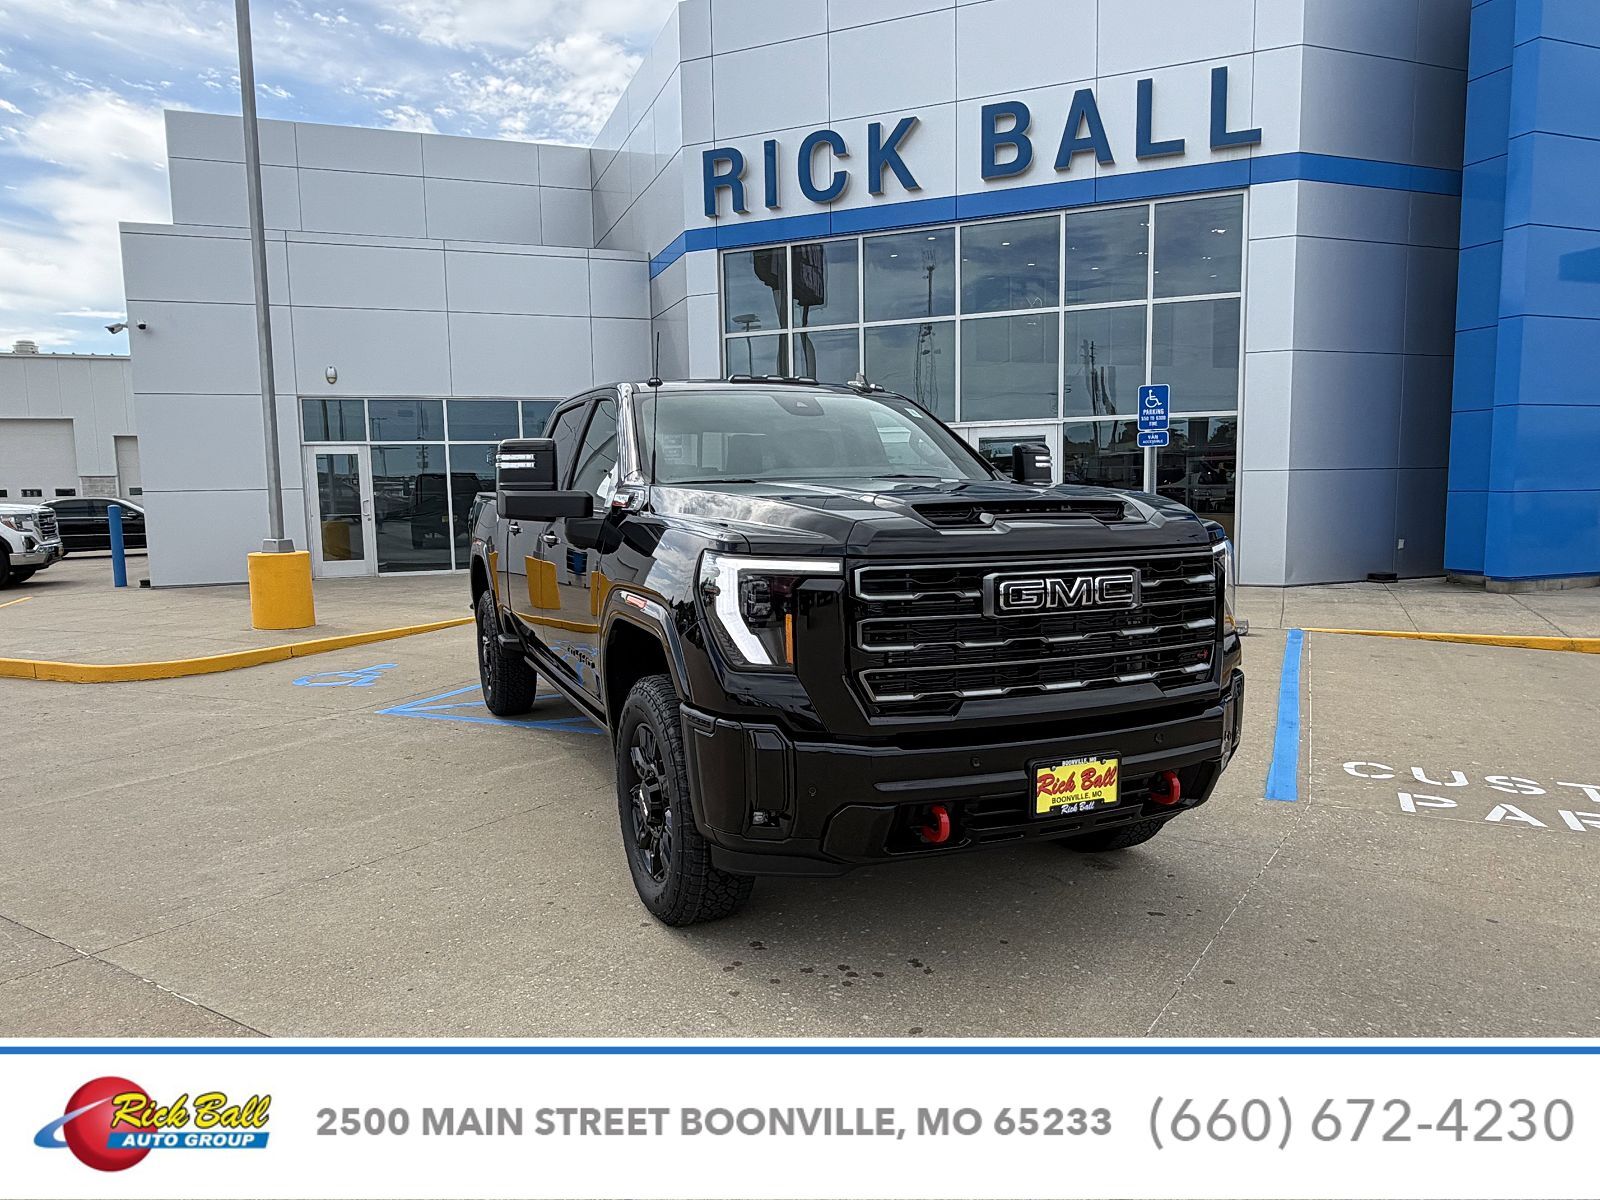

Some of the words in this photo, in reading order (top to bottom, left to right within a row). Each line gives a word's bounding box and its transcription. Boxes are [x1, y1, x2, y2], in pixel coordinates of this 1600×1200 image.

[702, 116, 922, 218] RICK
[981, 66, 1262, 182] BALL
[1000, 574, 1134, 612] GMC
[1037, 771, 1077, 797] Rick
[1081, 766, 1117, 791] Ball
[1092, 790, 1103, 798] MO
[1061, 803, 1078, 815] Rick
[1080, 801, 1095, 812] Ball
